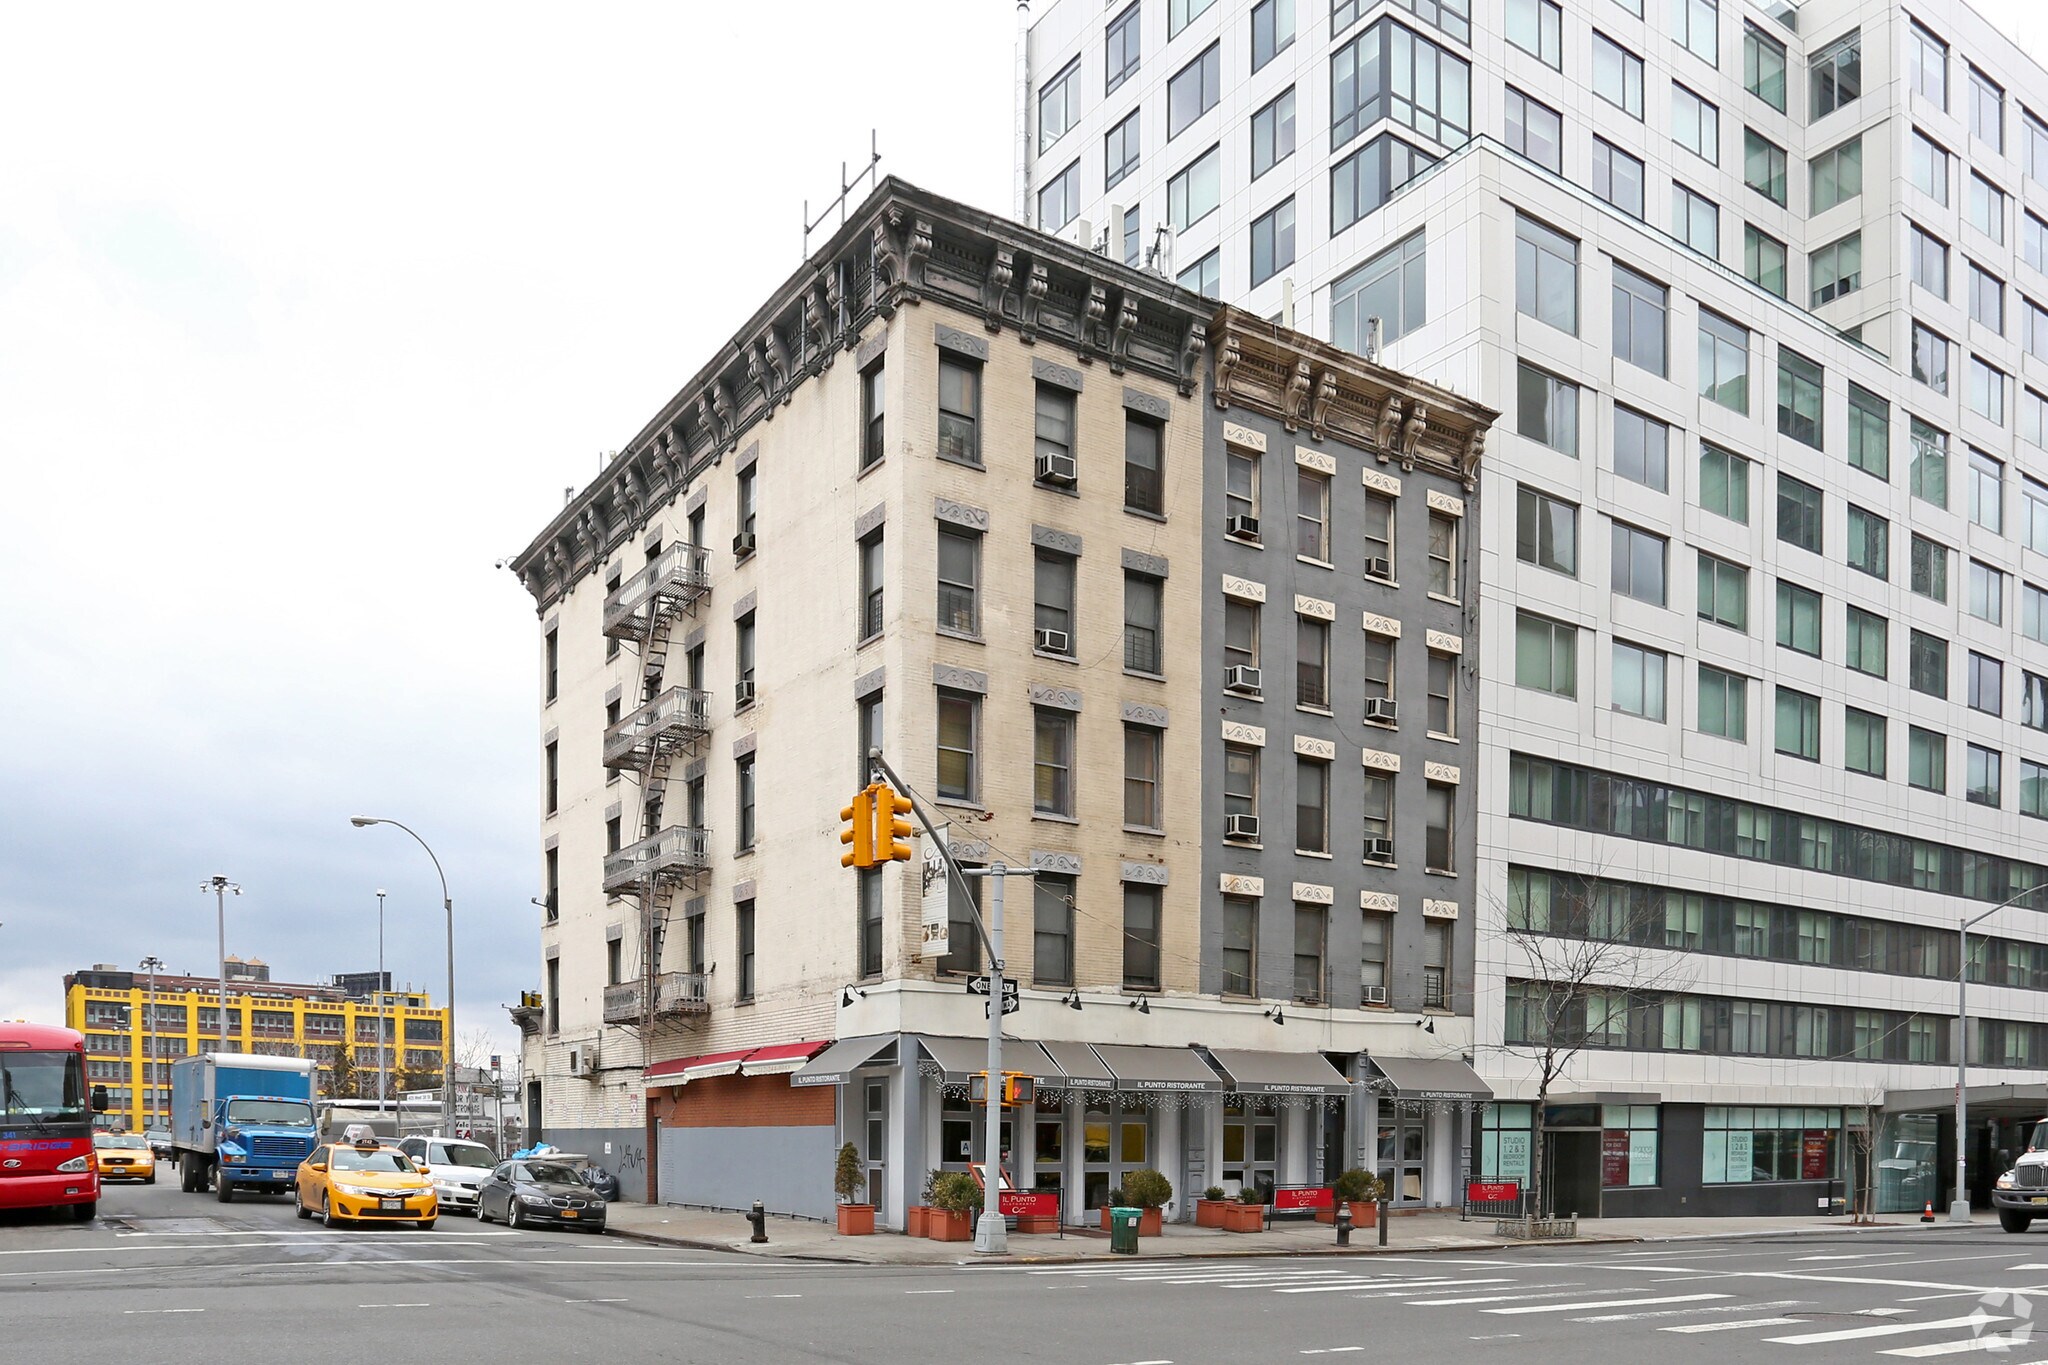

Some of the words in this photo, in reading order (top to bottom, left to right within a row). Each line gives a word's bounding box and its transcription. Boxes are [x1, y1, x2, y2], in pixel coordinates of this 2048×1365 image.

[976, 981, 991, 990] ONE
[803, 1075, 816, 1083] PUNTO
[816, 1074, 841, 1083] RISTORANTE
[1144, 1081, 1166, 1089] PUNTO
[1166, 1082, 1206, 1090] RISTORANTE
[3, 1131, 16, 1139] 341
[963, 1142, 969, 1151] A
[1010, 1195, 1037, 1203] PUNTO
